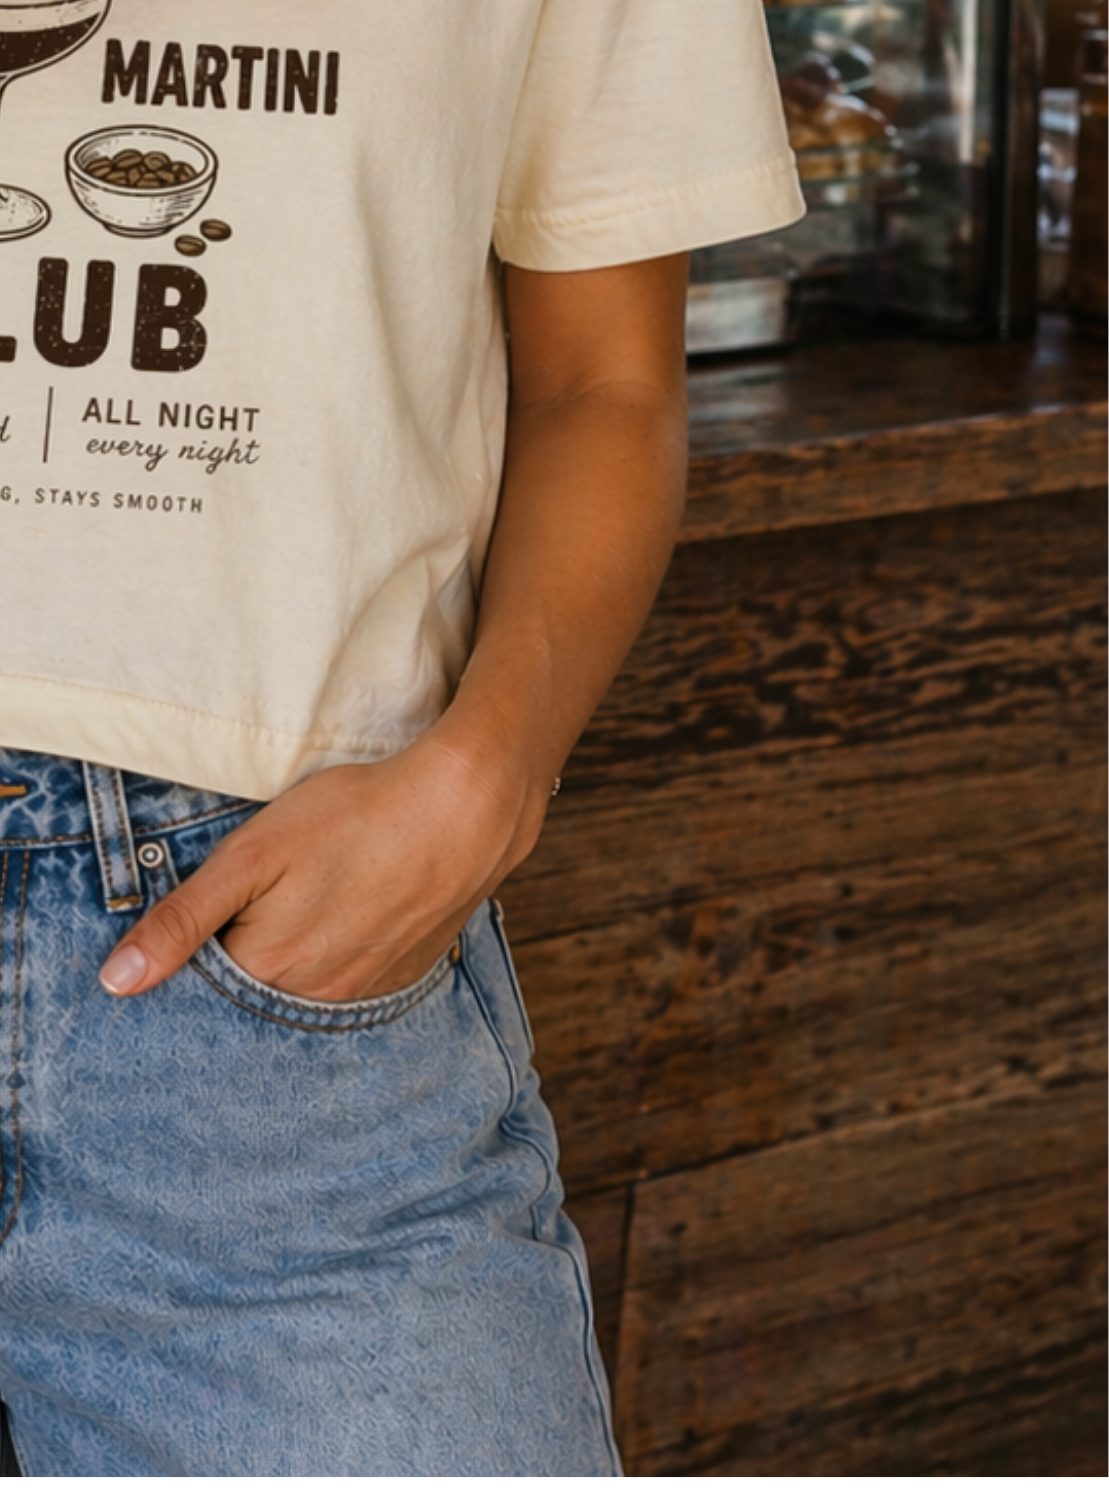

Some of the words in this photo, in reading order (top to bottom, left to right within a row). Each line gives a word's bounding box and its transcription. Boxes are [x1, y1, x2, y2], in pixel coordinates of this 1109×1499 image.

[101, 38, 340, 116] MARTINI
[81, 397, 141, 427] ALL
[158, 401, 261, 433] NIGHT
[85, 438, 168, 473] every
[178, 439, 261, 475] night
[34, 488, 102, 509] STAYS
[112, 493, 204, 514] SMOOTH
